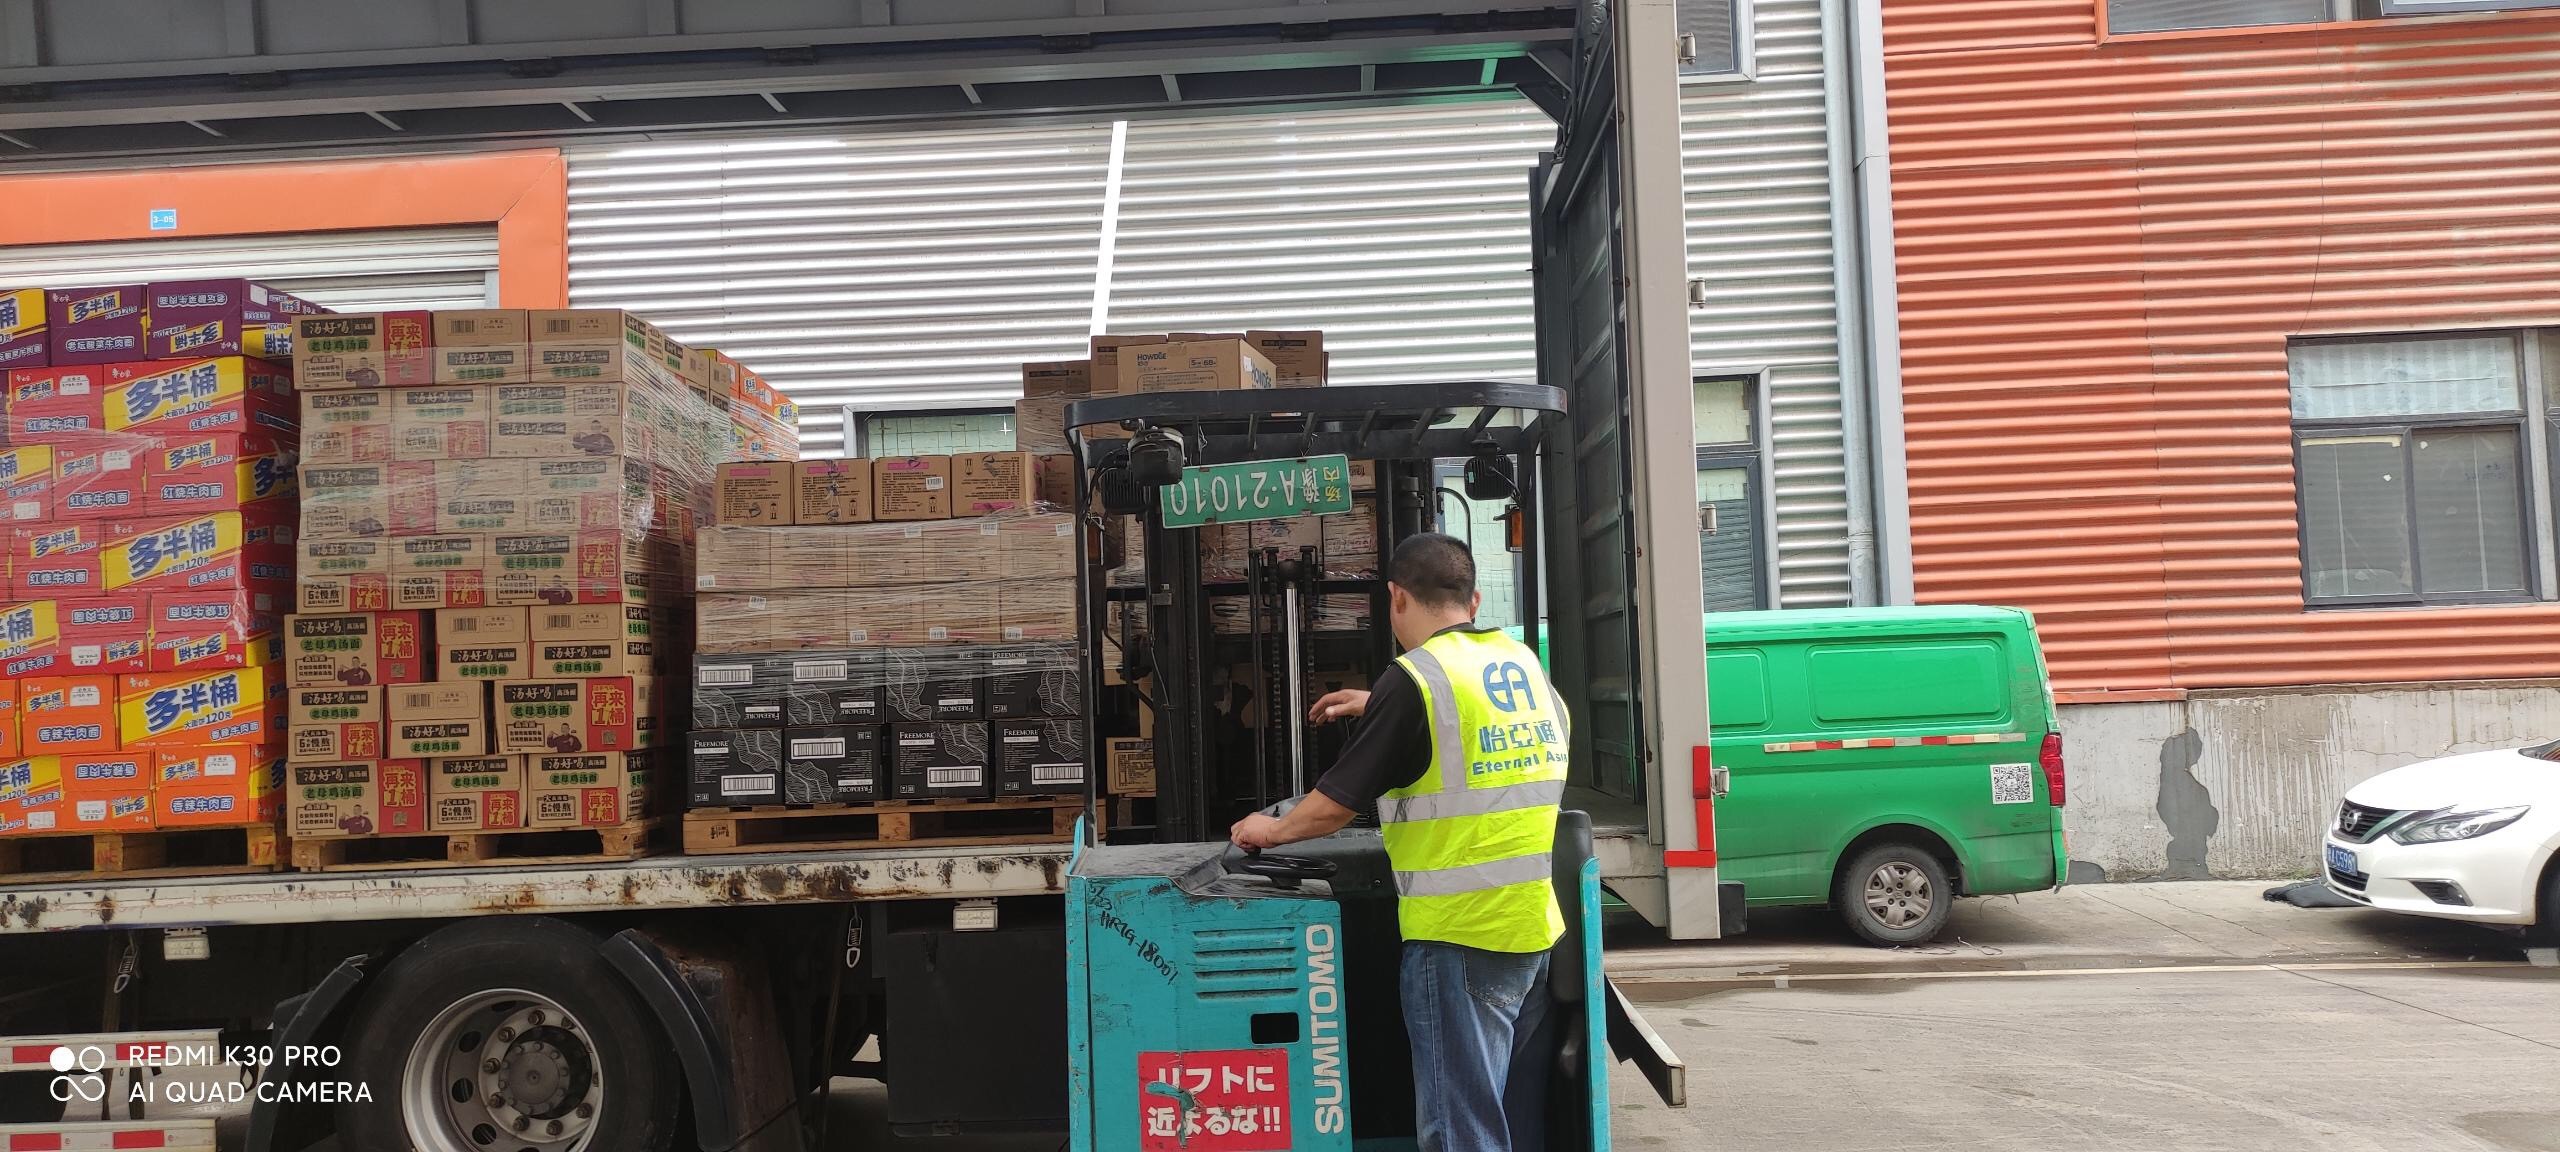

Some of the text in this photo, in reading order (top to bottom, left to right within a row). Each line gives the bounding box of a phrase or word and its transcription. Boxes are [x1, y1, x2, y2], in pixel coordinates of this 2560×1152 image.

[72, 293, 118, 323] 多半桶
[309, 320, 350, 335] 汤好喝
[124, 362, 220, 423] 多半桶
[25, 416, 89, 432] 红烧牛肉面
[188, 410, 241, 431] 红烧牛肉面
[168, 442, 214, 470] 多半桶
[161, 482, 222, 499] 红烧牛肉面
[68, 491, 130, 508] 红烧牛肉面
[34, 527, 77, 558] 多半桶
[127, 519, 217, 579] 多半桶
[28, 570, 89, 586] 红烧牛肉面
[188, 567, 236, 587] 红烧牛肉面
[72, 607, 134, 624] 红烧牛肉面
[166, 604, 231, 621] 红烧牛肉面
[302, 621, 342, 634] 汤好喝
[382, 623, 414, 640] 再来
[178, 632, 222, 663] 多半桶
[302, 638, 362, 651] 老母鸡汤面
[382, 640, 415, 659] 1桶
[552, 646, 588, 659] 汤好喝
[458, 650, 495, 662] 汤好喝
[7, 655, 54, 675] 红烧牛肉面
[28, 690, 63, 712] 多半桶
[309, 692, 345, 704] 汤好喝
[512, 686, 552, 700] 汤好喝
[593, 691, 625, 707] 再来
[144, 673, 240, 733] 多半桶
[512, 704, 571, 717] 老母鸡汤面
[939, 705, 974, 713] FREEMORE
[593, 707, 626, 725] 1桶
[745, 711, 780, 722] FREEMORE
[841, 706, 875, 717] FREEMORE
[39, 725, 102, 743] 香辣牛肉面
[210, 720, 260, 742] 香辣牛肉面
[349, 729, 374, 741] 再来
[410, 726, 446, 738] 汤好喝
[899, 731, 935, 739] FREEMORE
[1003, 728, 1039, 737] FREEMORE
[349, 741, 375, 756] 1桶
[411, 741, 461, 753] 老母鸡汤面
[694, 740, 729, 748] FREEMORE
[450, 760, 486, 773] 汤好喝
[548, 756, 585, 769] 汤好喝
[1472, 753, 1541, 775] Eternal
[76, 762, 137, 780] 香辣牛肉面
[303, 768, 344, 782] 汤好喝
[550, 772, 599, 785] 老母鸡汤面
[385, 772, 416, 787] 再来
[303, 785, 363, 800] 老母鸡汤面
[383, 787, 417, 807] 1桶
[838, 786, 873, 794] FREEMORE
[172, 796, 235, 814] 香辣牛肉面
[489, 797, 514, 811] 再来
[589, 795, 614, 809] 再来
[588, 809, 614, 822] 1桶
[1305, 923, 1345, 1135] SUMITOMO
[1157, 1065, 1276, 1094] リフトに
[1147, 1106, 1281, 1138] 近よるな!!
